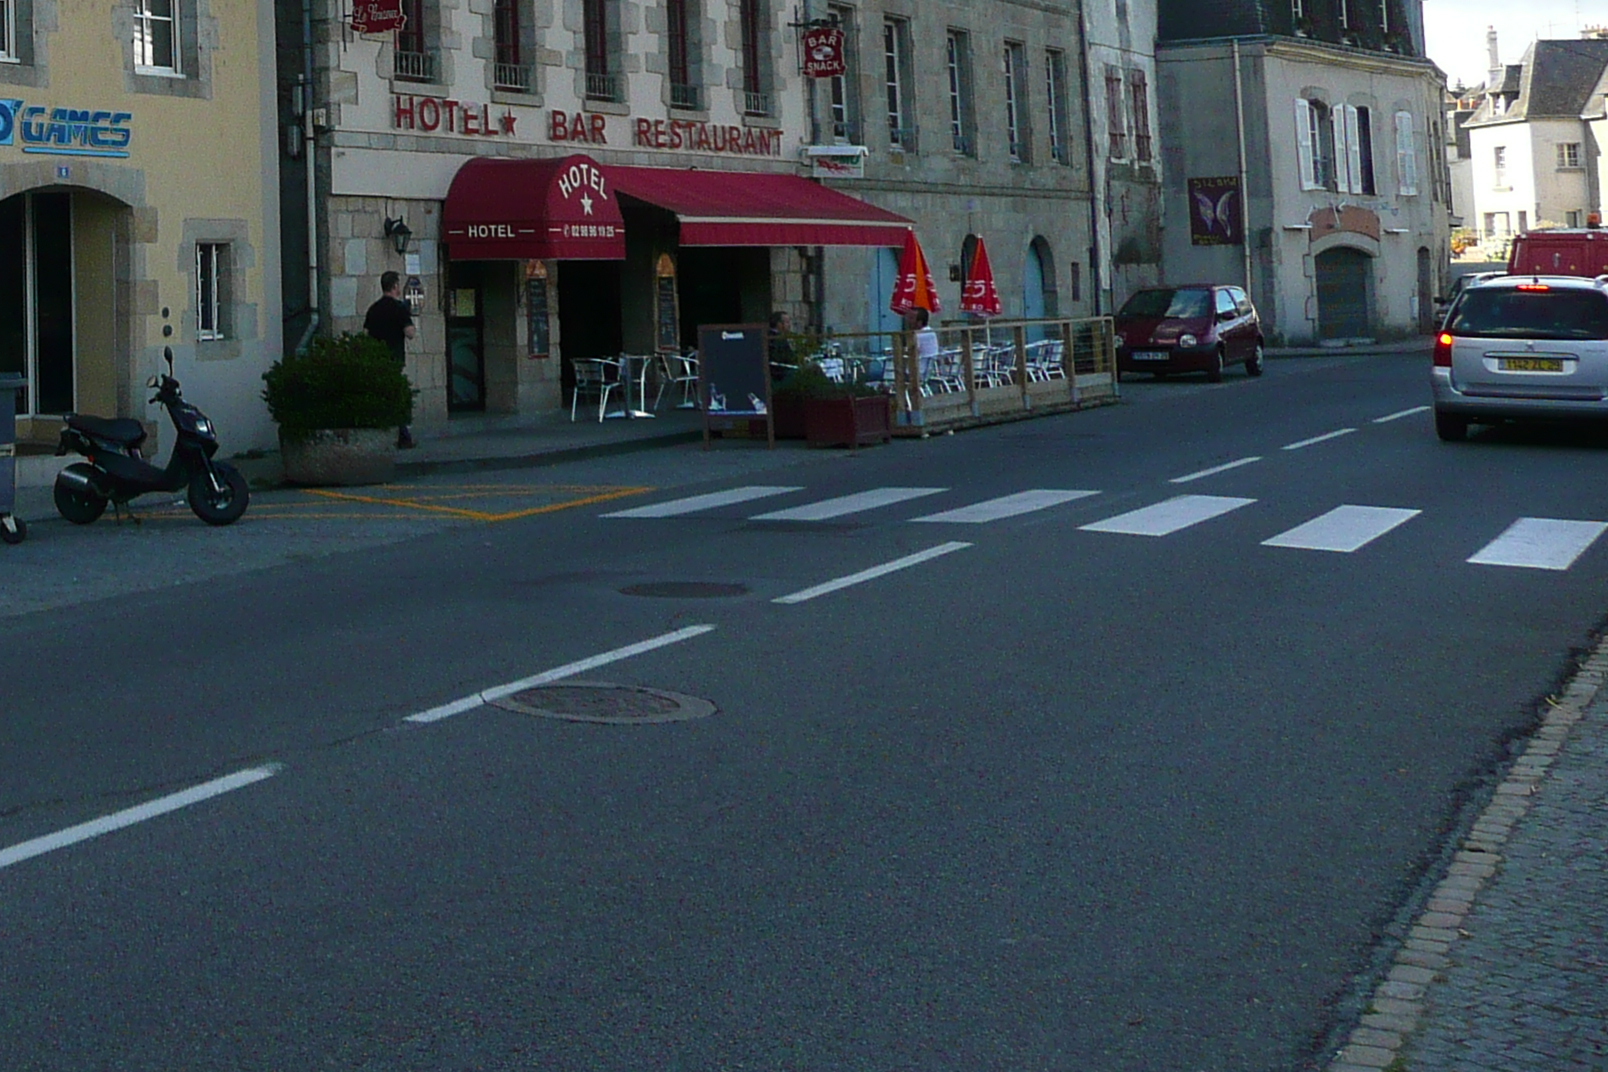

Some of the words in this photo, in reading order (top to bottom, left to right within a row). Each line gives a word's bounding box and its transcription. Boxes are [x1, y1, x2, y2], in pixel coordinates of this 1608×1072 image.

[808, 35, 837, 48] BAR
[807, 60, 841, 72] SNACK
[394, 96, 499, 137] HOTEL
[549, 109, 609, 146] BAR
[635, 116, 785, 157] RESTAURANT
[558, 163, 609, 201] HOTEL
[468, 224, 516, 238] HOTEL
